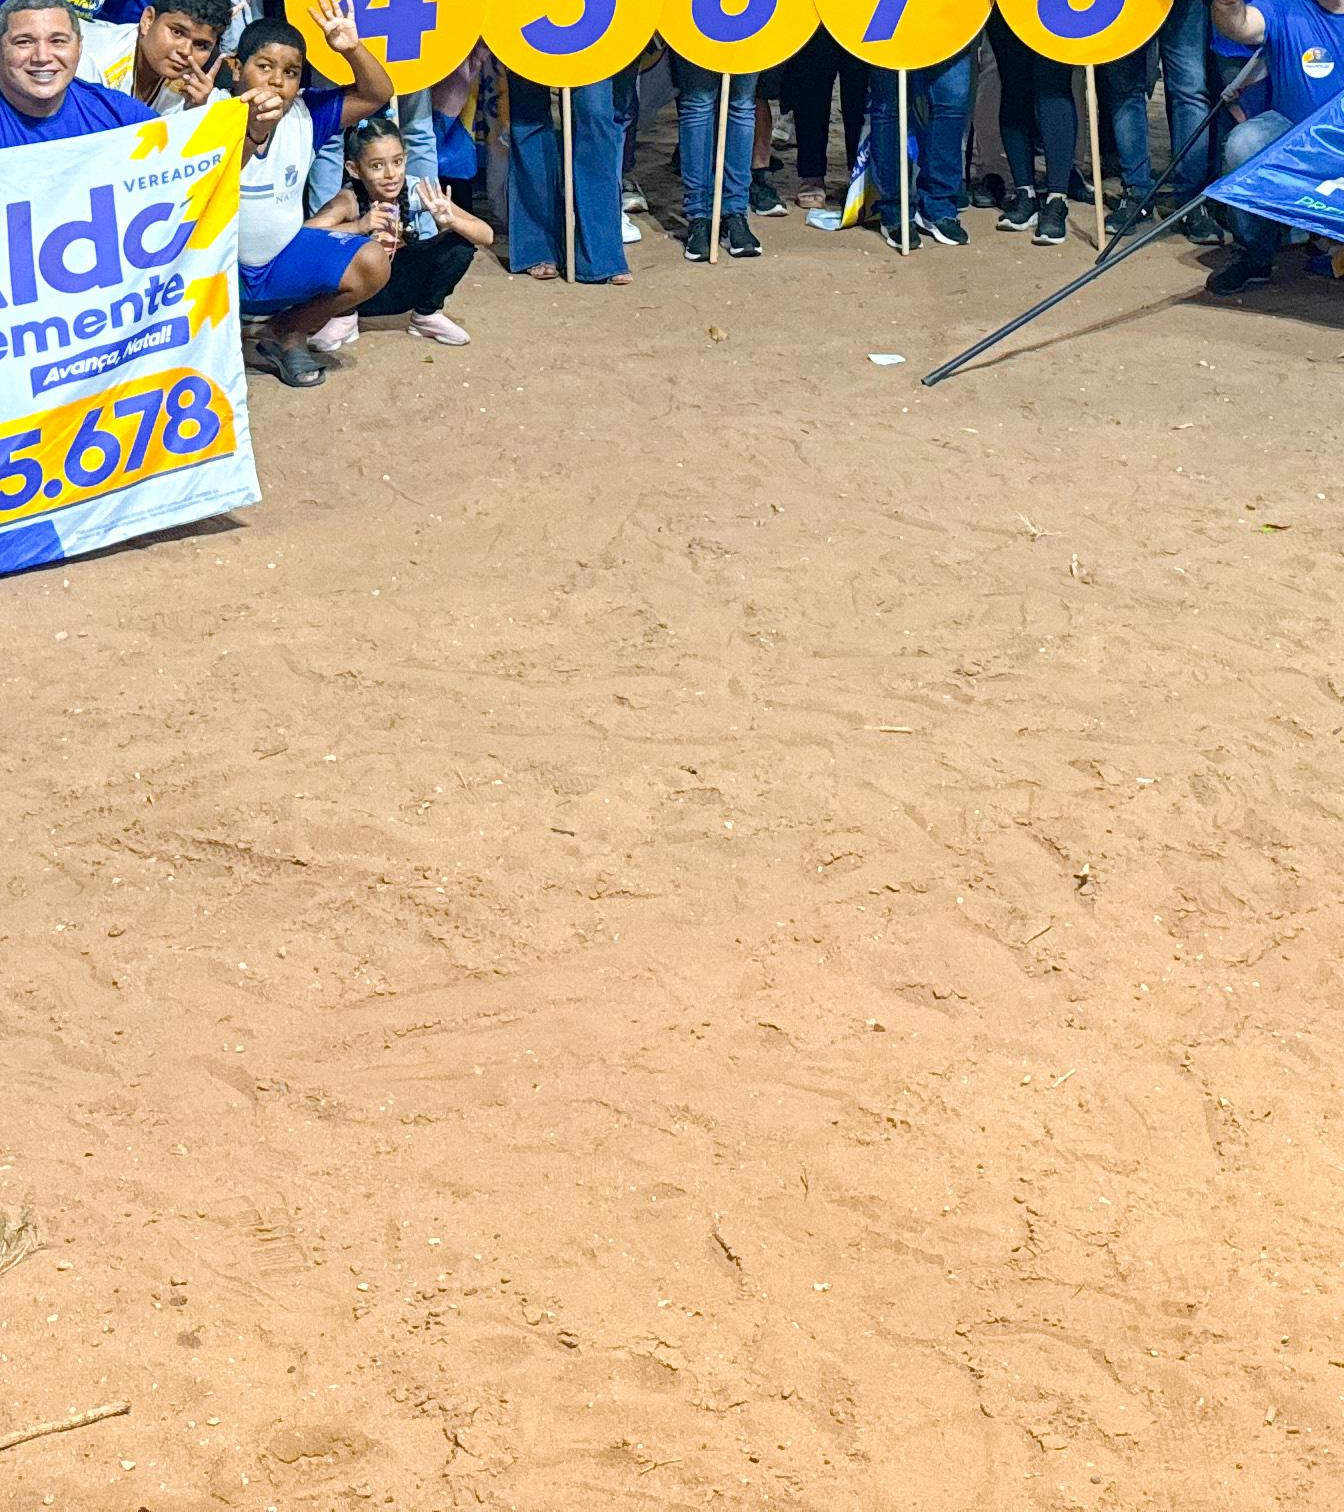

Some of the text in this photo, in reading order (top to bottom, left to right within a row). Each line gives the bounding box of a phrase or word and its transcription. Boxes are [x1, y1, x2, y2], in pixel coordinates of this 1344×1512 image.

[122, 153, 224, 193] VEREADOR
[42, 323, 173, 387] Avança, Natal!
